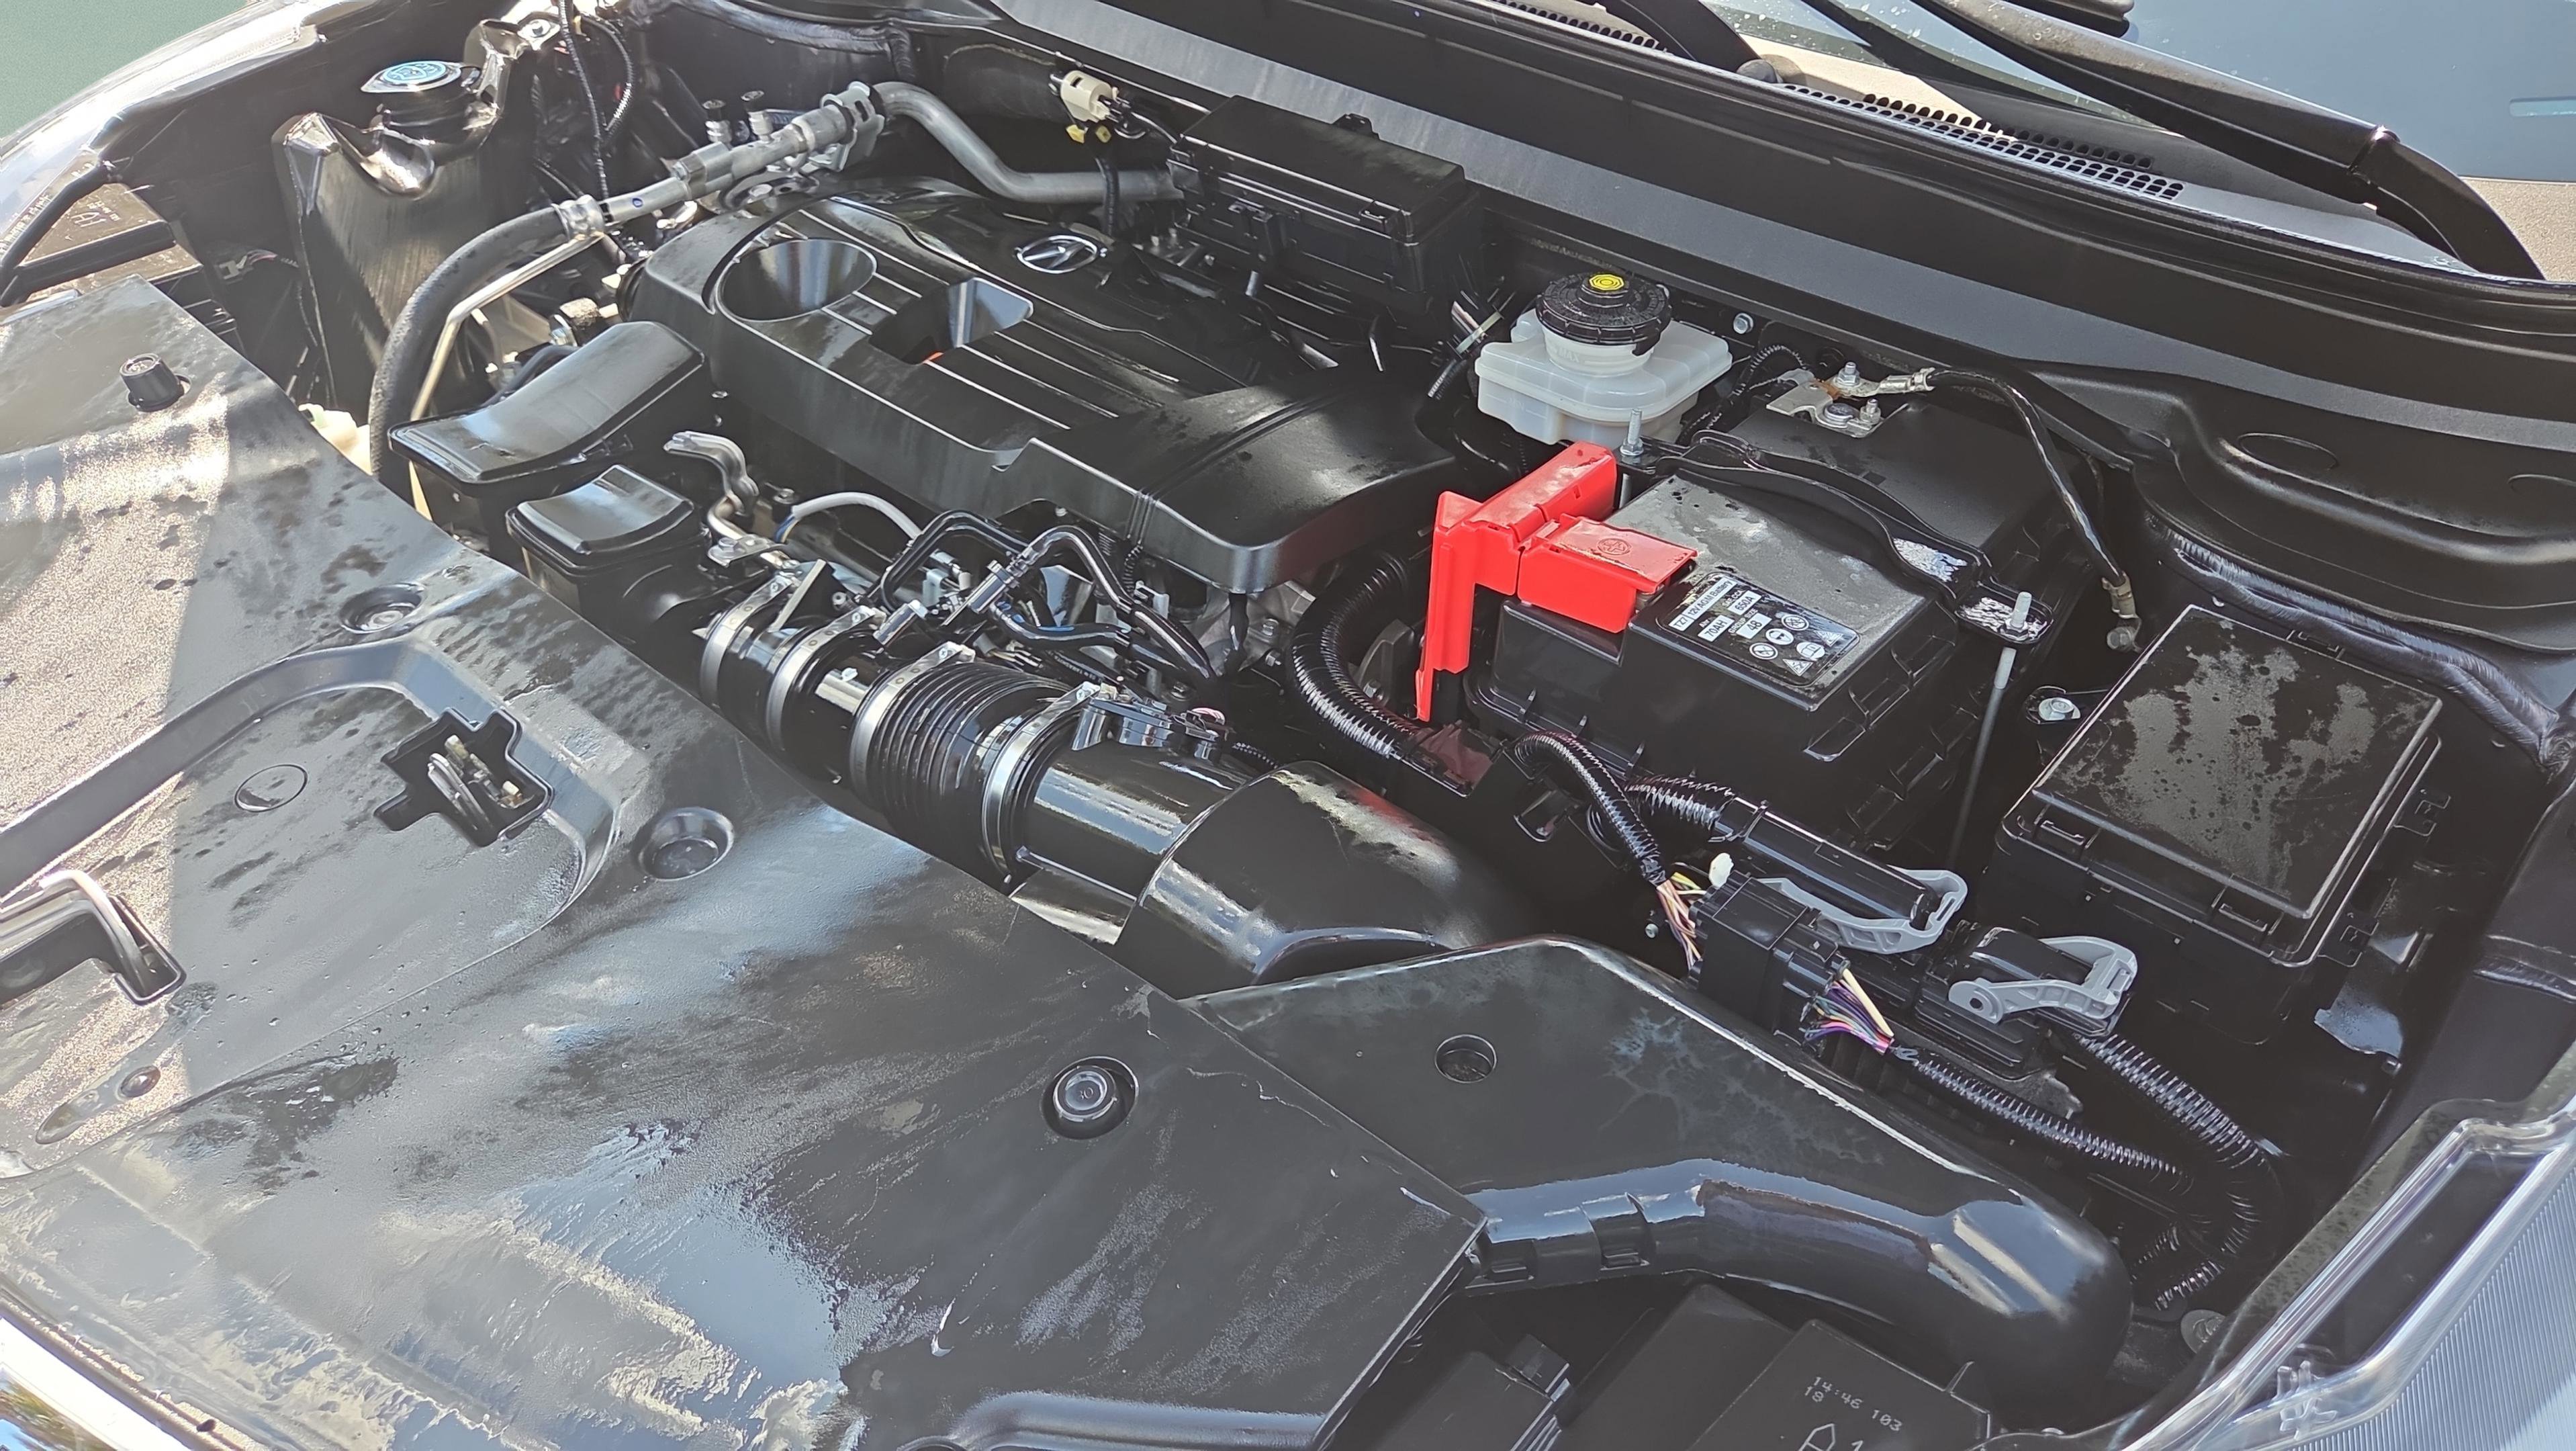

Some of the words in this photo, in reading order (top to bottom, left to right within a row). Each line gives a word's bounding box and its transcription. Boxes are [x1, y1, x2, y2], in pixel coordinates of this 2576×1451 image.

[1688, 606, 1700, 616] 12V
[1697, 595, 1713, 609] AGM
[1711, 580, 1733, 597] Battery
[1732, 590, 1744, 599] CCA
[1734, 596, 1754, 611] 650A
[1704, 619, 1727, 637] 70AH
[1728, 617, 1747, 634] GROUP
[1744, 608, 1757, 619] SIZE
[1747, 619, 1762, 631] 48
[1805, 1386, 1824, 1403] 18
[1872, 1409, 1902, 1432] 103
